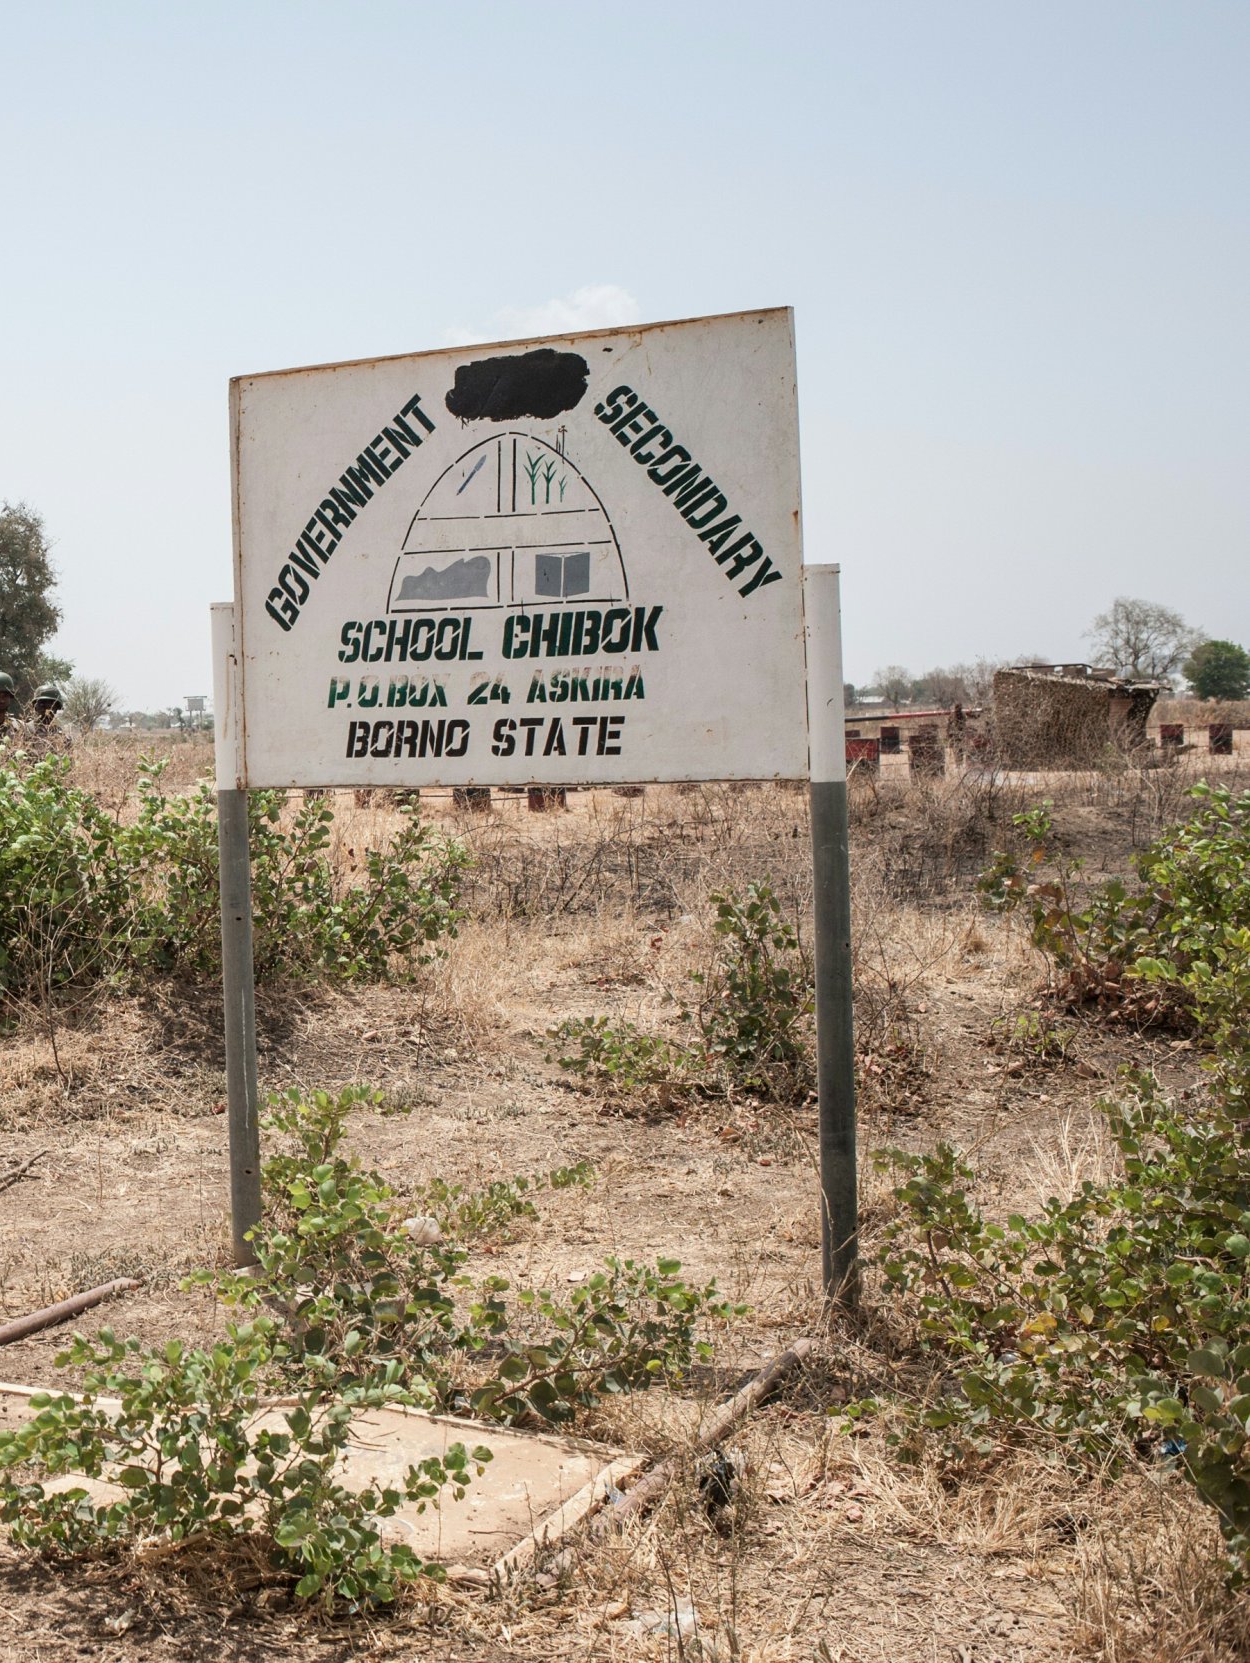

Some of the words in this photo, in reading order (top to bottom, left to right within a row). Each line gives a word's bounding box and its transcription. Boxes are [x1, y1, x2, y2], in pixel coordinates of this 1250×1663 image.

[264, 393, 437, 632] GOVERNMENT
[594, 385, 783, 598] SECONDARY
[337, 617, 483, 663] SCHOOL
[501, 606, 663, 659] CHIBOK
[466, 671, 511, 705] 24
[526, 664, 645, 704] ASKIRA
[345, 719, 470, 758] BORNO
[491, 716, 626, 758] STATE
